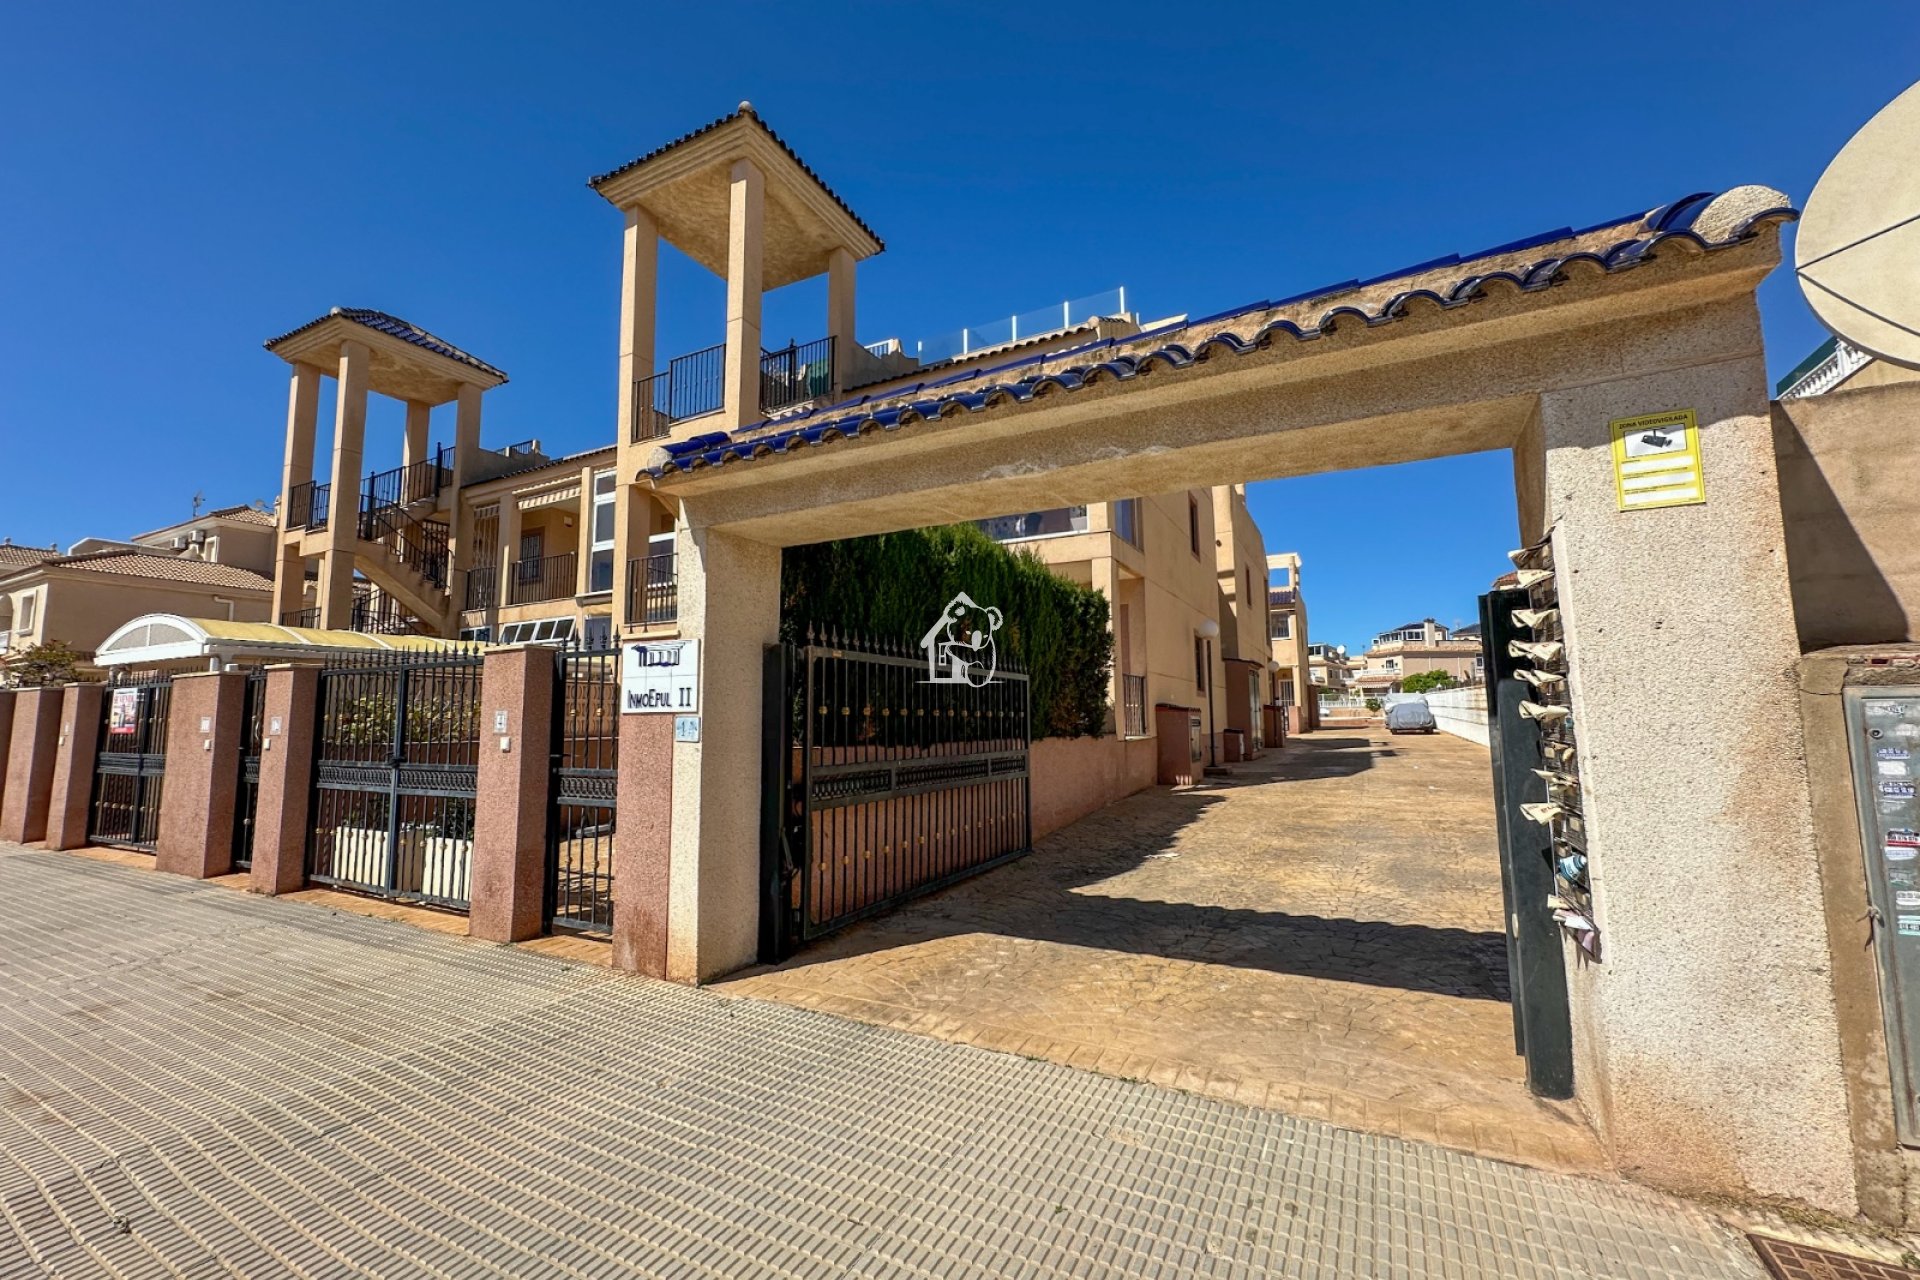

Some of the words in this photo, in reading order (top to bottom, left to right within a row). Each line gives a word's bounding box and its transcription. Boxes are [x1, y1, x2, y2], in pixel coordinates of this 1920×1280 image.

[1619, 422, 1637, 430] ZONA
[1638, 414, 1688, 427] VIDEOVIGILADA
[679, 687, 691, 707] II
